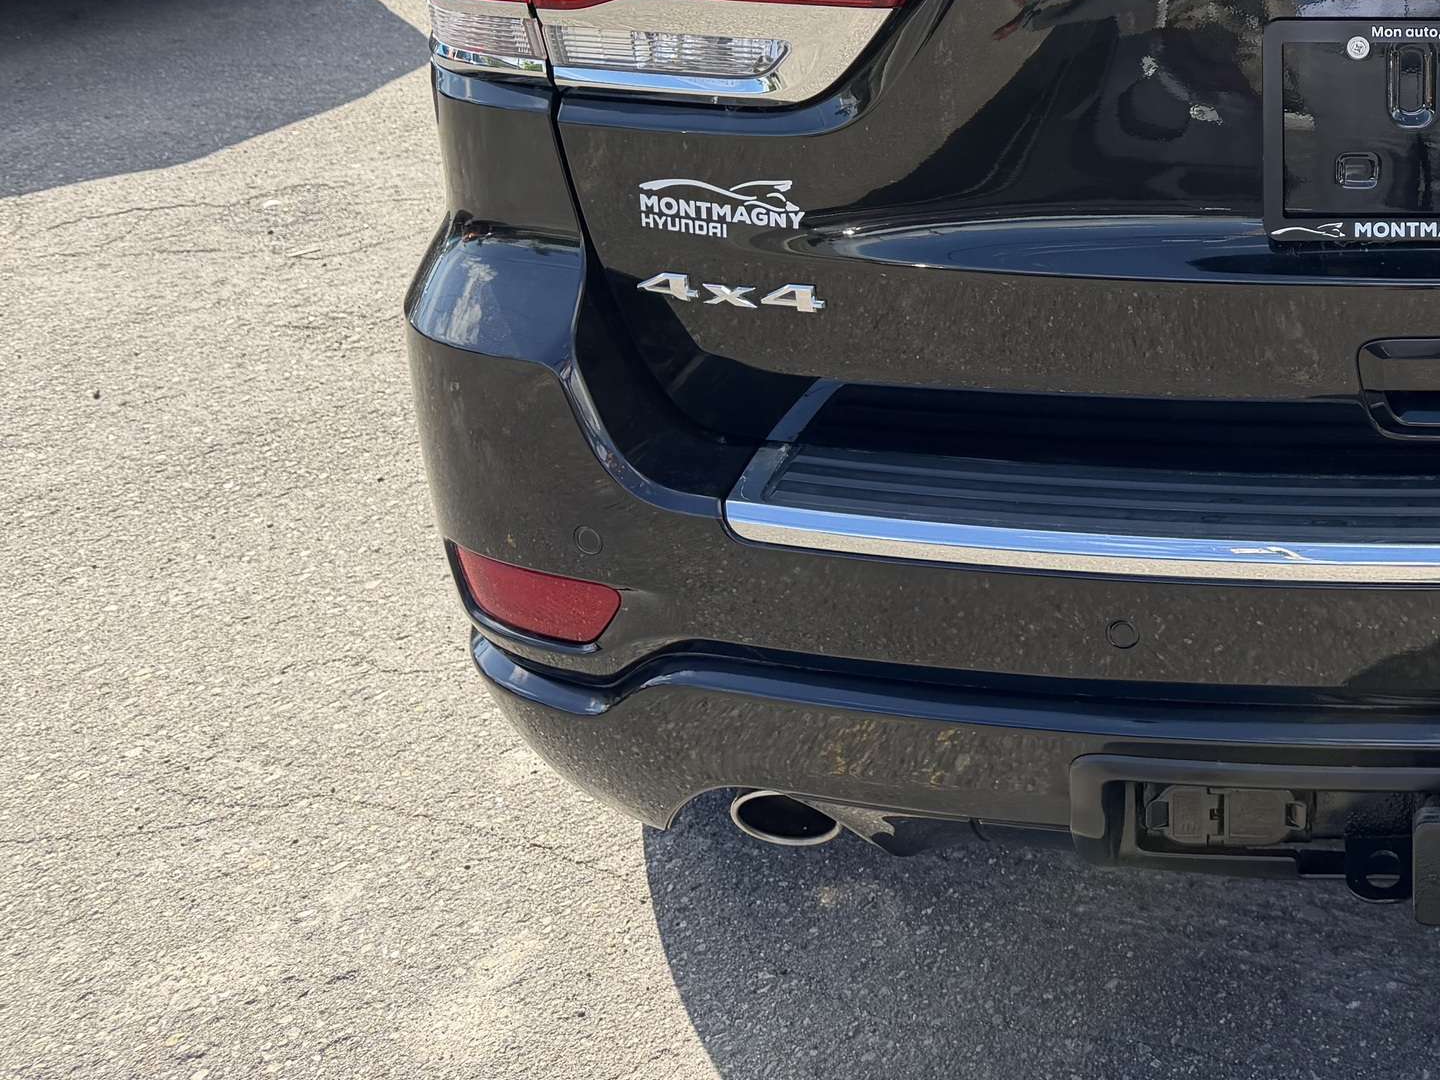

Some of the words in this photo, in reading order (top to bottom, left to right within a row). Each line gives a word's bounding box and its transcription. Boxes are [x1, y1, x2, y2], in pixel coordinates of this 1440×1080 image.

[1371, 26, 1401, 38] Mon
[639, 193, 806, 230] MONTMAGNY
[641, 212, 728, 239] HYUNDAI
[636, 272, 826, 313] 4x4
